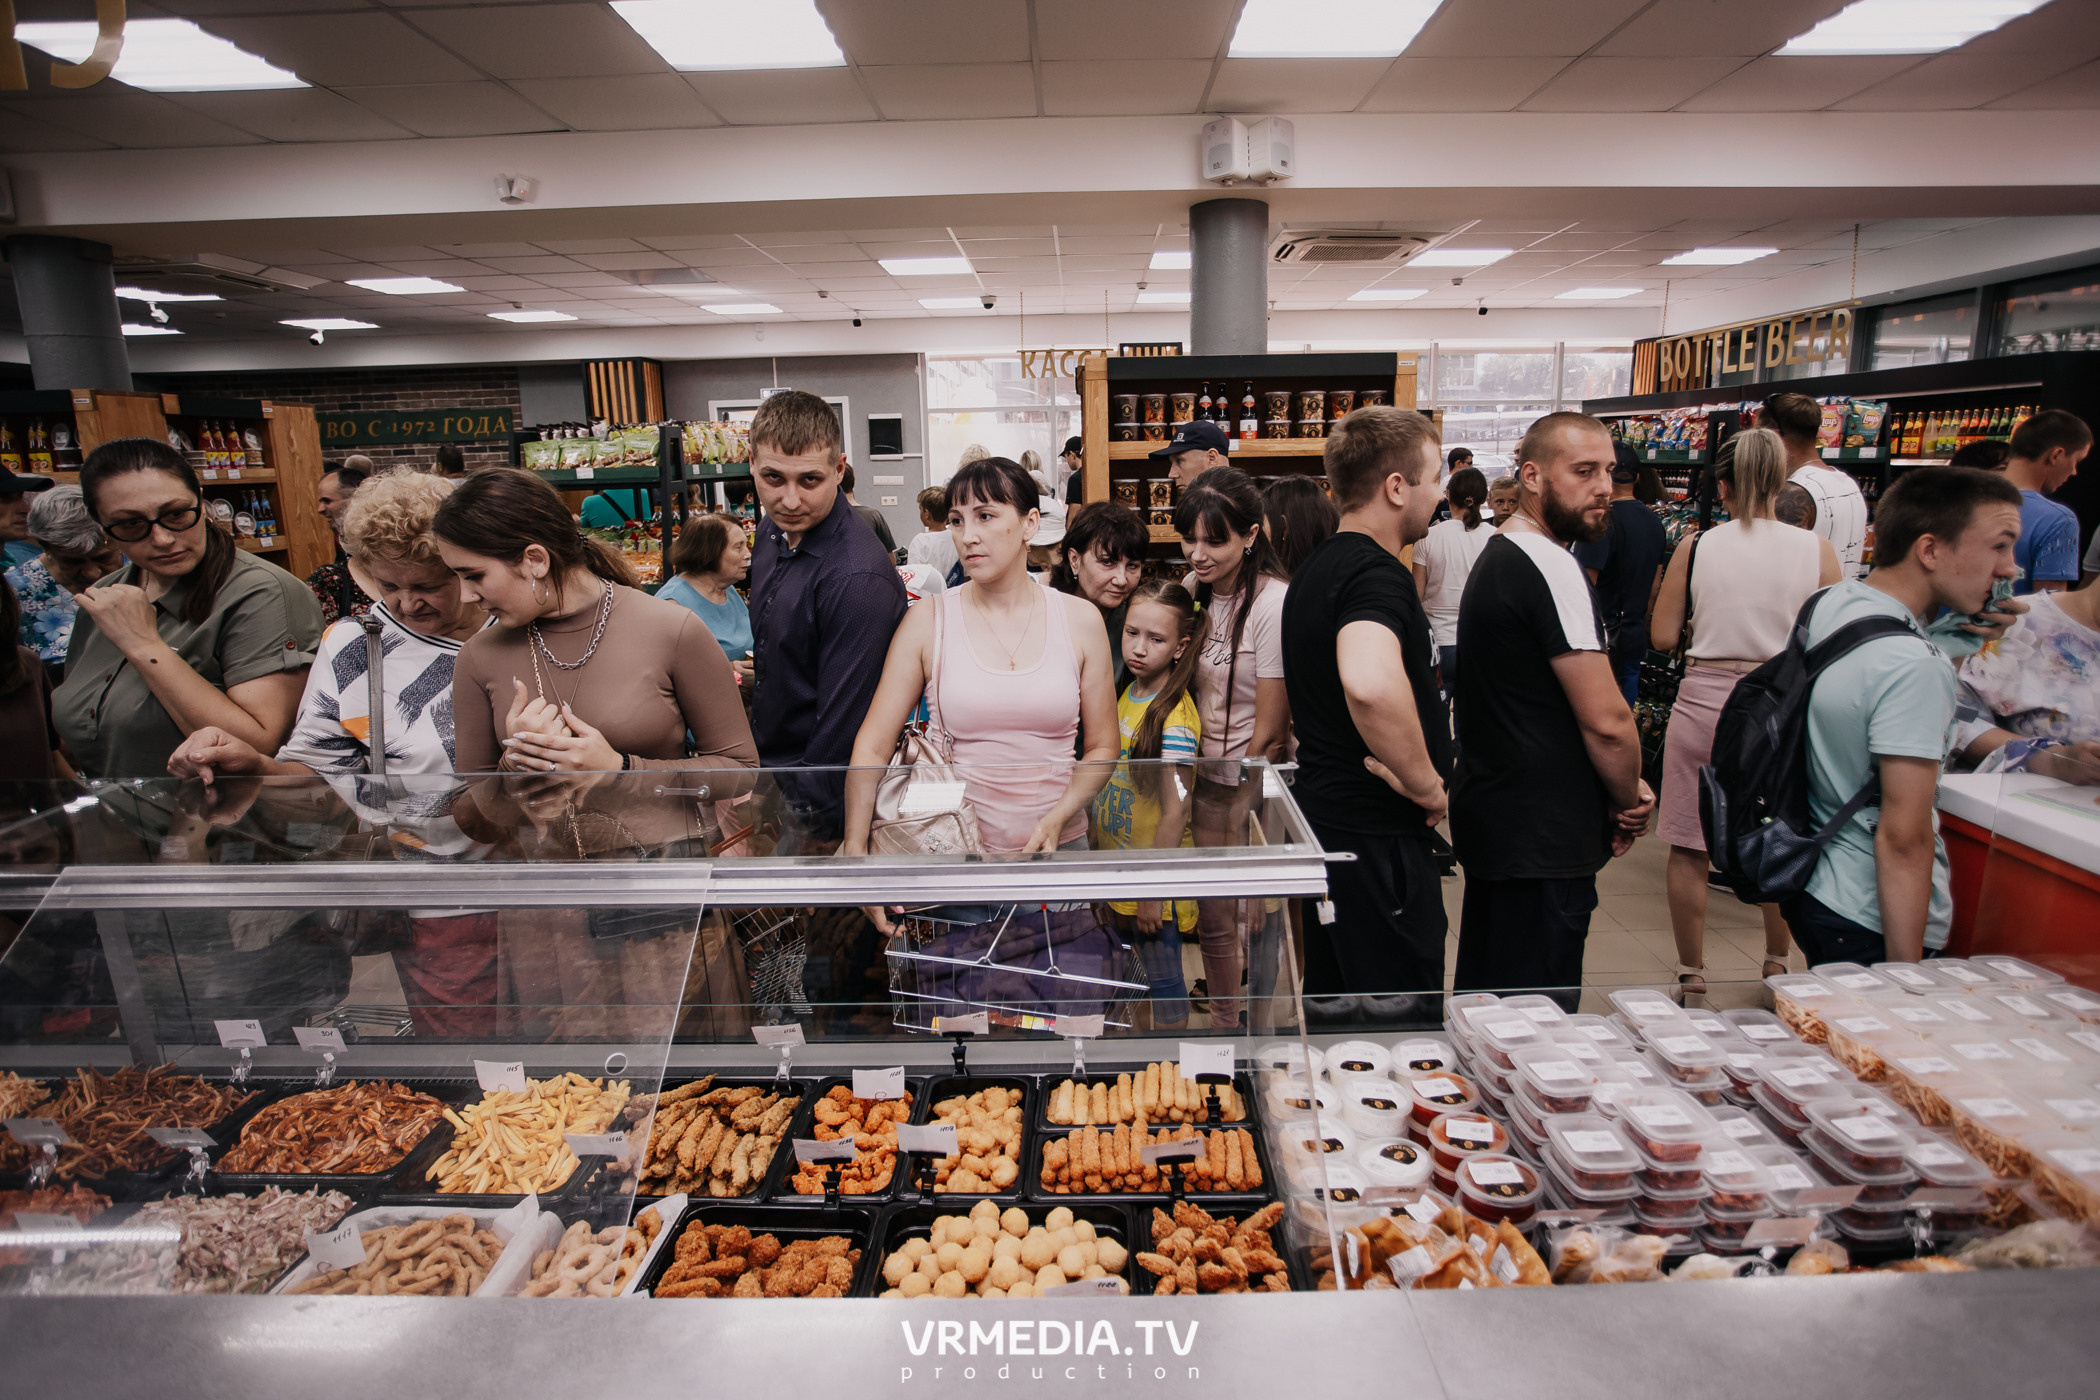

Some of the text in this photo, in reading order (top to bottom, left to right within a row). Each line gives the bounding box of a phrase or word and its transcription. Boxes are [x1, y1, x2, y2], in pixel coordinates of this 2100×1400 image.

[1660, 307, 1851, 382] BOTTLE BEER
[368, 419, 382, 437] С
[392, 421, 435, 436] 1972
[443, 416, 507, 438] ГОДА
[333, 1227, 351, 1244] 1117
